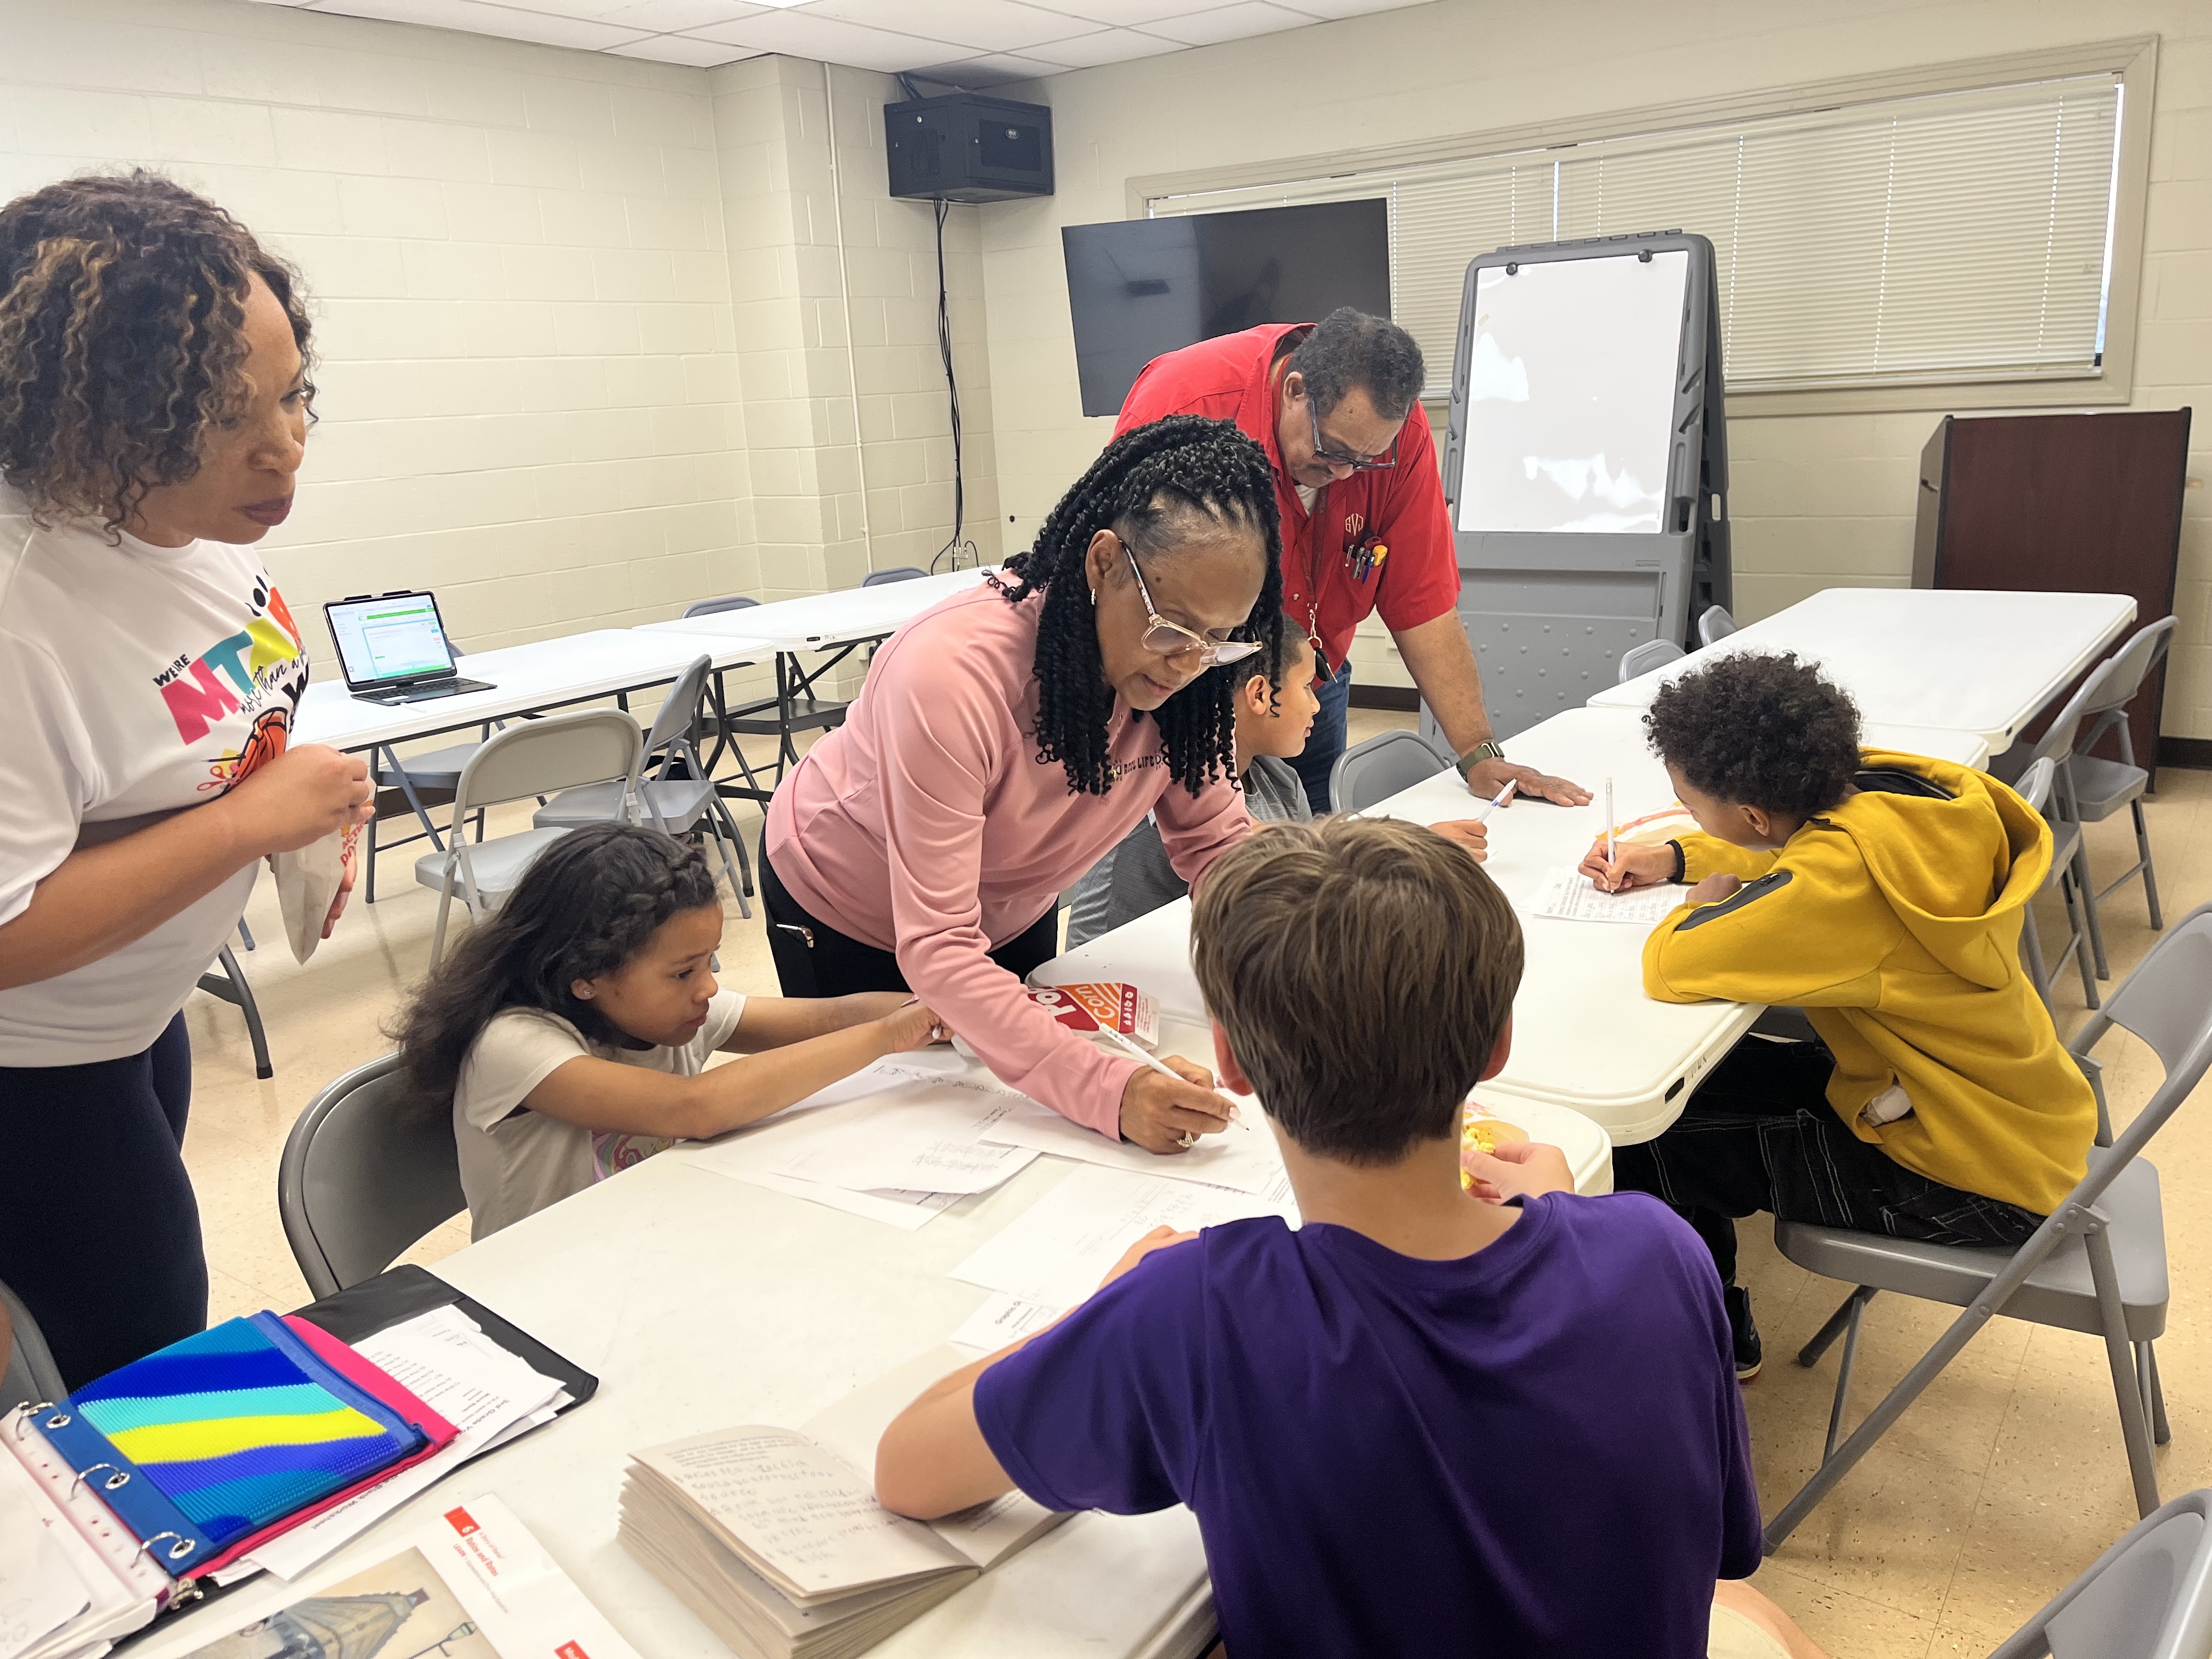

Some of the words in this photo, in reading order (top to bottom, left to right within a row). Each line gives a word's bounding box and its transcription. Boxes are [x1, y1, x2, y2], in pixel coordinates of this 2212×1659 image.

[252, 664, 287, 697] than
[1137, 755, 1154, 769] LIFE
[1075, 985, 1115, 1019] Corn
[461, 1525, 475, 1533] 6
[453, 1543, 467, 1557] LEARN
[466, 1537, 480, 1553] Ratios
[477, 1552, 490, 1563] and
[484, 1560, 498, 1577] Rates
